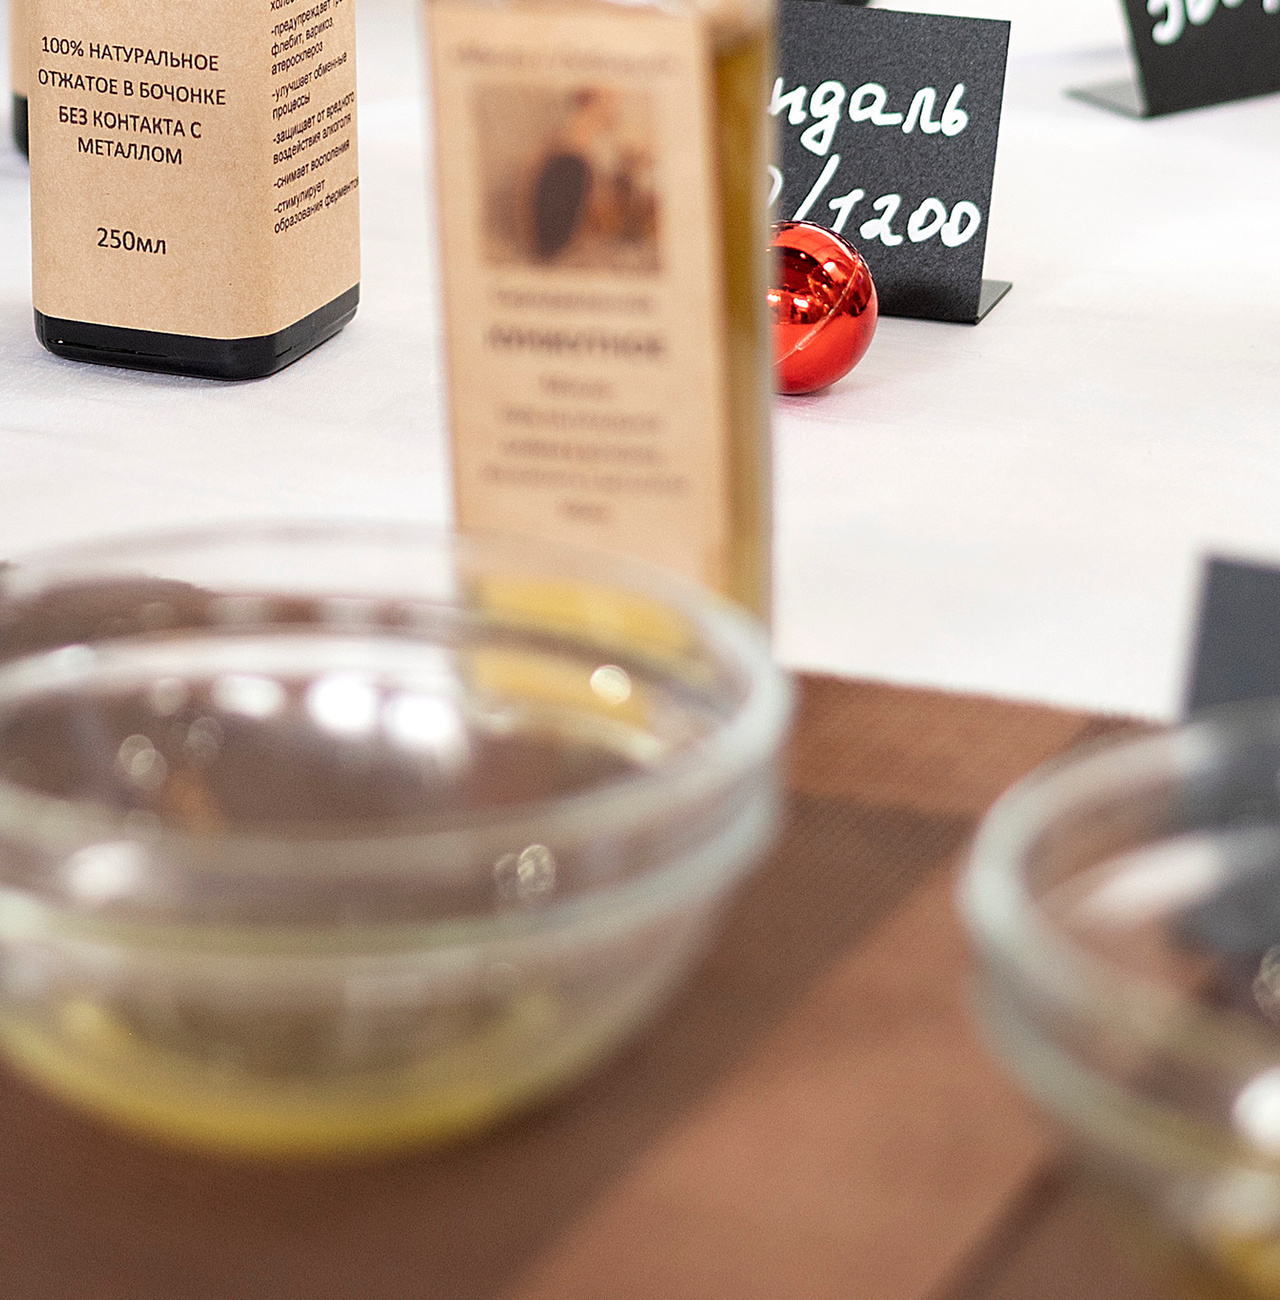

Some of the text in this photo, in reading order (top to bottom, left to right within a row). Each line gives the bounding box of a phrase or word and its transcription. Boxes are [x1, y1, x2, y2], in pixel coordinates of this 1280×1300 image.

[41, 36, 219, 71] 100% НАТУРАЛЬНОЕ
[271, 41, 324, 76] атеросклероз
[314, 52, 347, 80] обменные
[38, 68, 227, 106] ОТЖАТОЕ В БОЧОНКЕ
[58, 105, 202, 139] БЕЗ КОНТАКТА С
[273, 92, 311, 120] процессы
[317, 109, 325, 124] от
[768, 76, 970, 157] ндаль
[77, 137, 183, 165] МЕТАЛЛОМ
[273, 132, 321, 165] воздействия
[274, 176, 359, 234] образования ферменто
[96, 227, 167, 255] 250мл
